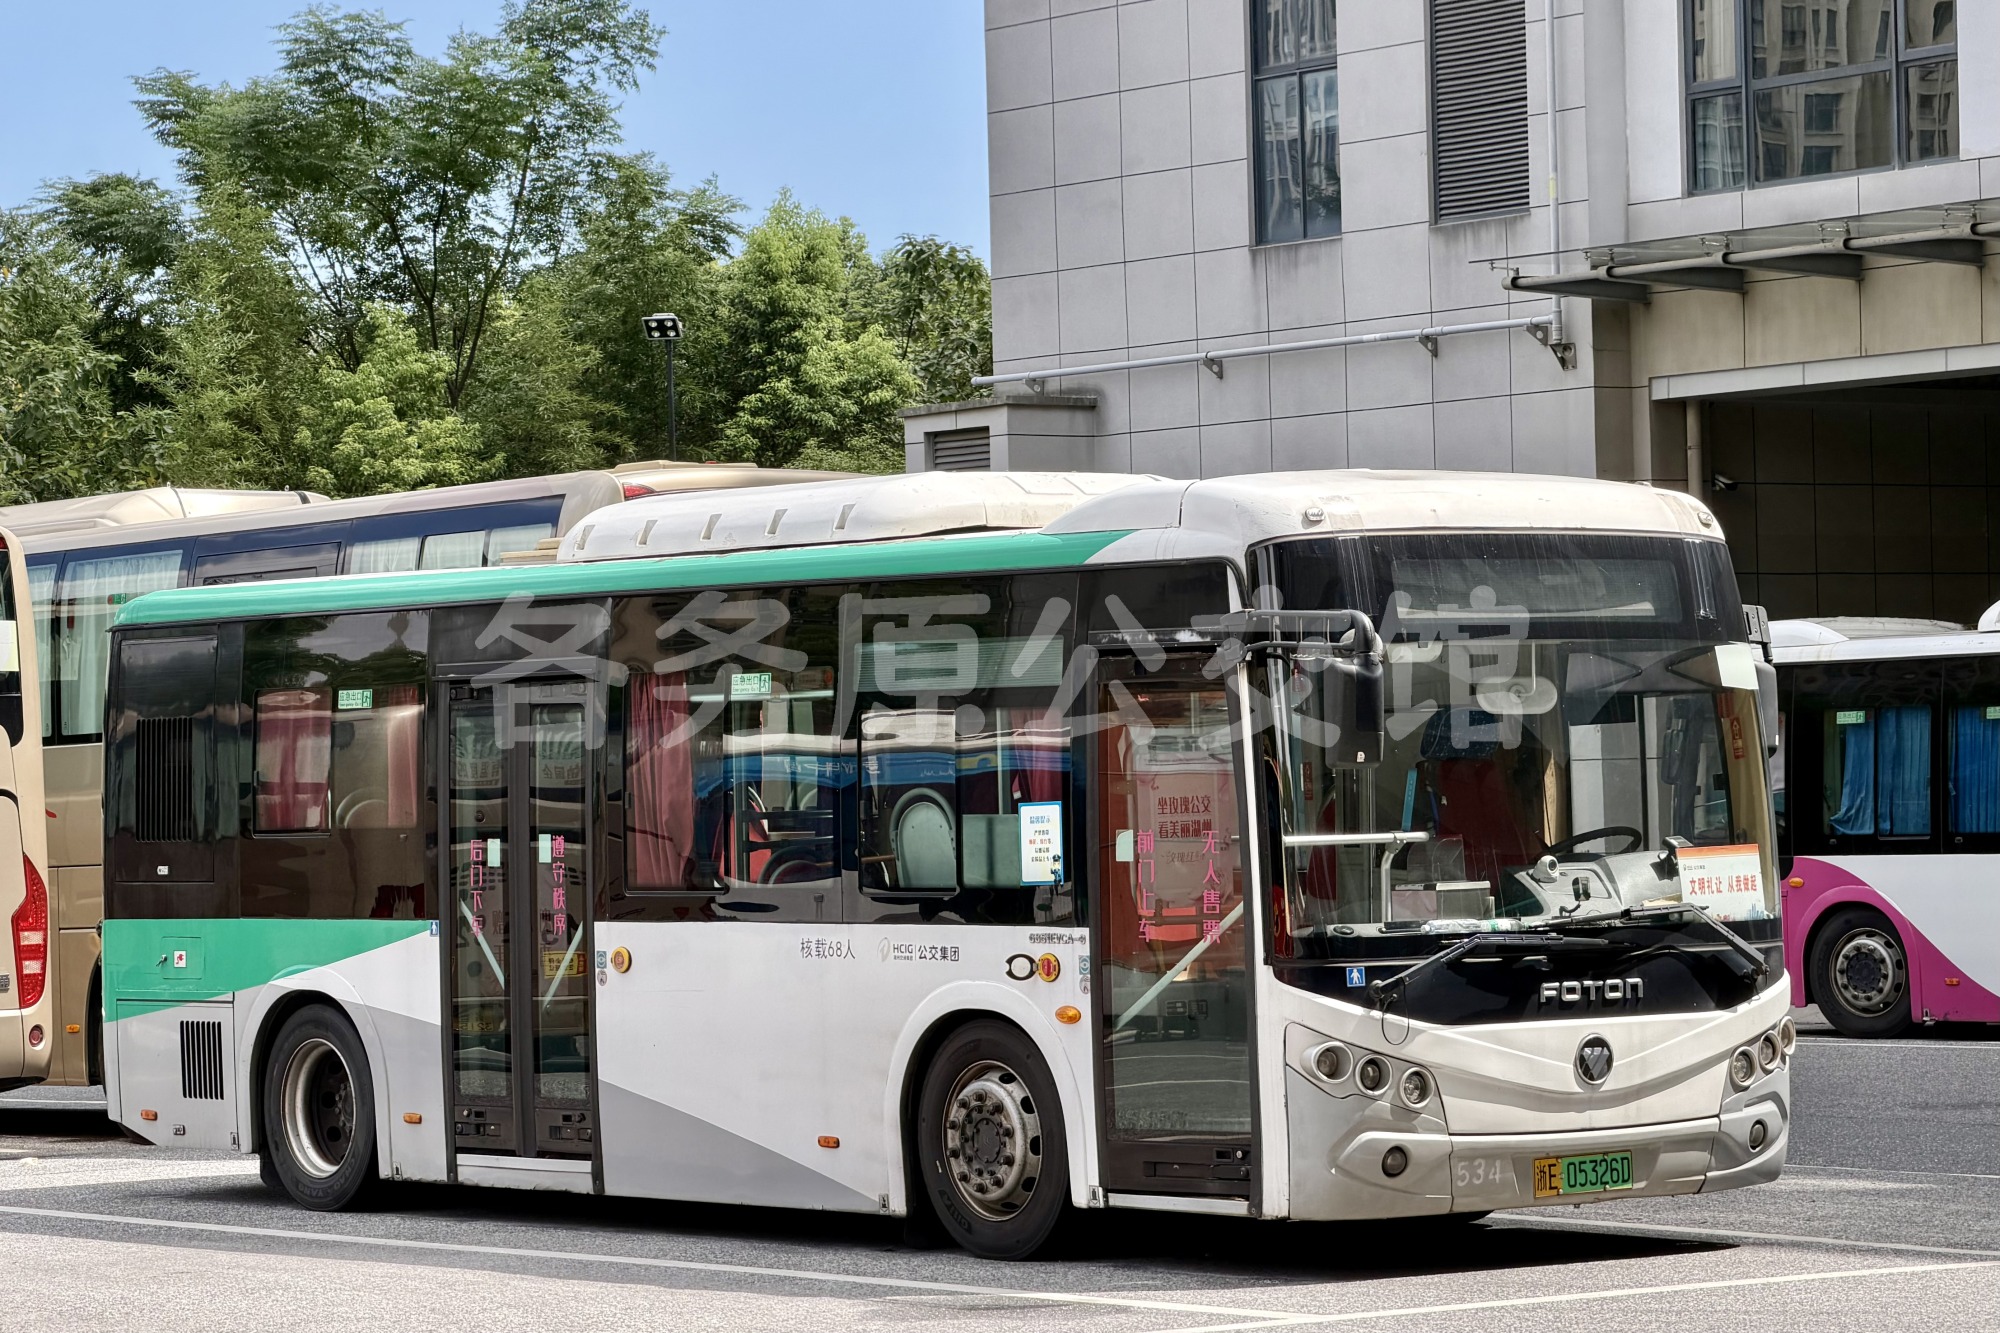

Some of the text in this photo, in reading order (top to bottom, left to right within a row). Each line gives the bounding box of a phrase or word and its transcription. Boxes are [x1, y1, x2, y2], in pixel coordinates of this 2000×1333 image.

[732, 675, 759, 686] 应急出口
[1157, 795, 1212, 815] 坐玫瑰公交
[470, 839, 484, 938] 后门下车
[552, 834, 566, 936] 遵守秩序
[1137, 829, 1156, 943] 前门上车
[1202, 830, 1221, 944] 无人售票
[1689, 874, 1758, 896] 文明礼让 从我做起
[800, 937, 856, 960] 核载68人
[892, 943, 914, 954] HCIG
[917, 944, 960, 962] 公交集团
[1540, 977, 1644, 1003] FOTON
[1456, 1158, 1502, 1188] 534
